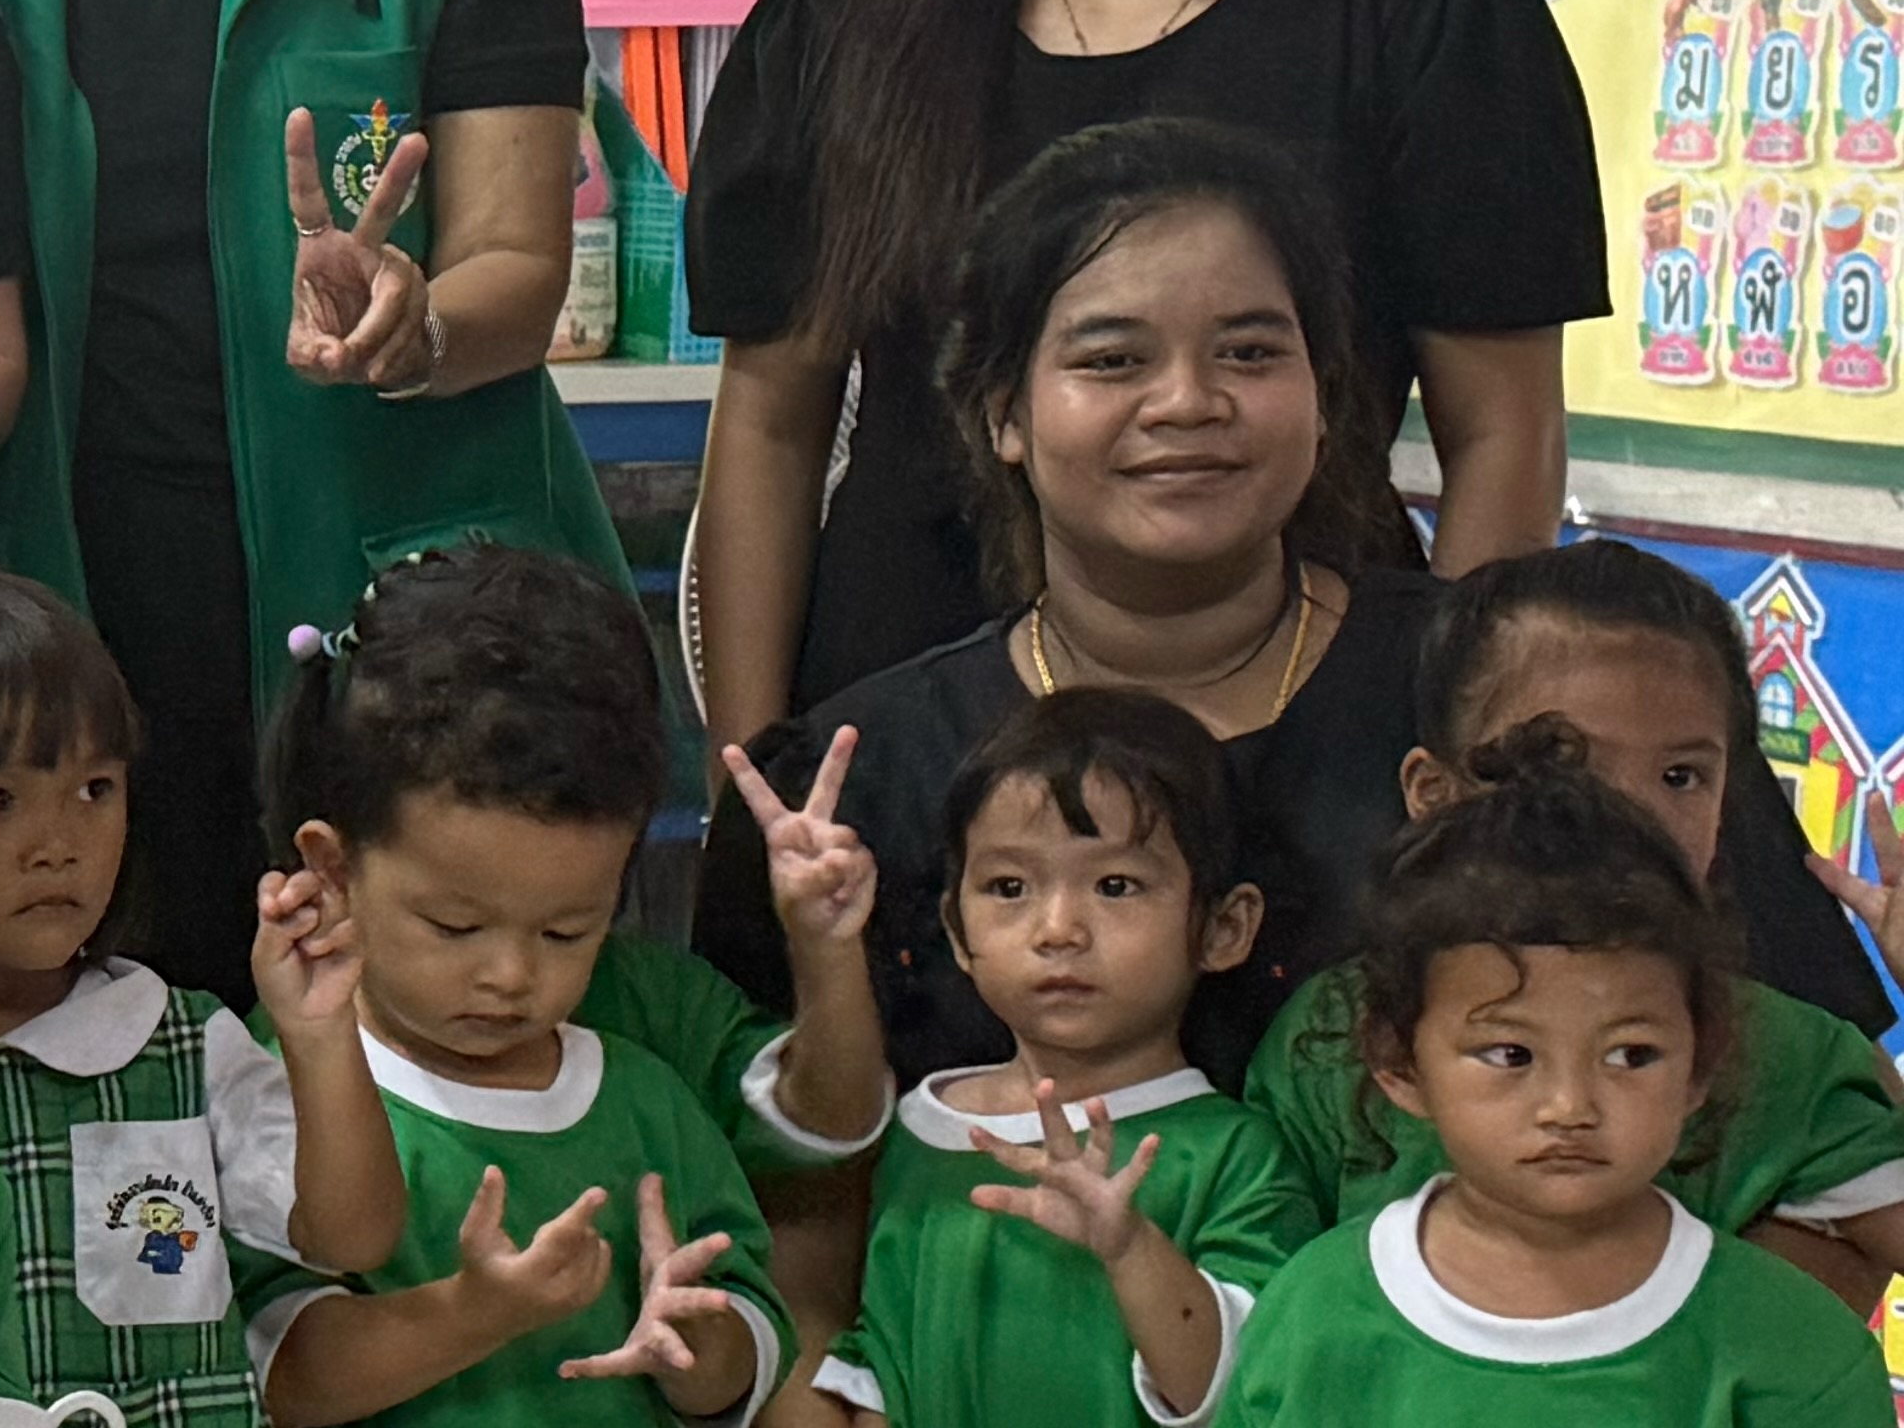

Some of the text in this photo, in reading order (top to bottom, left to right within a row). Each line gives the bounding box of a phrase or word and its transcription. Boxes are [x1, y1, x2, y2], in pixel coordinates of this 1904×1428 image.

[1676, 42, 1884, 110] ม ย ร
[1657, 260, 1870, 334] ห ฬ อ
